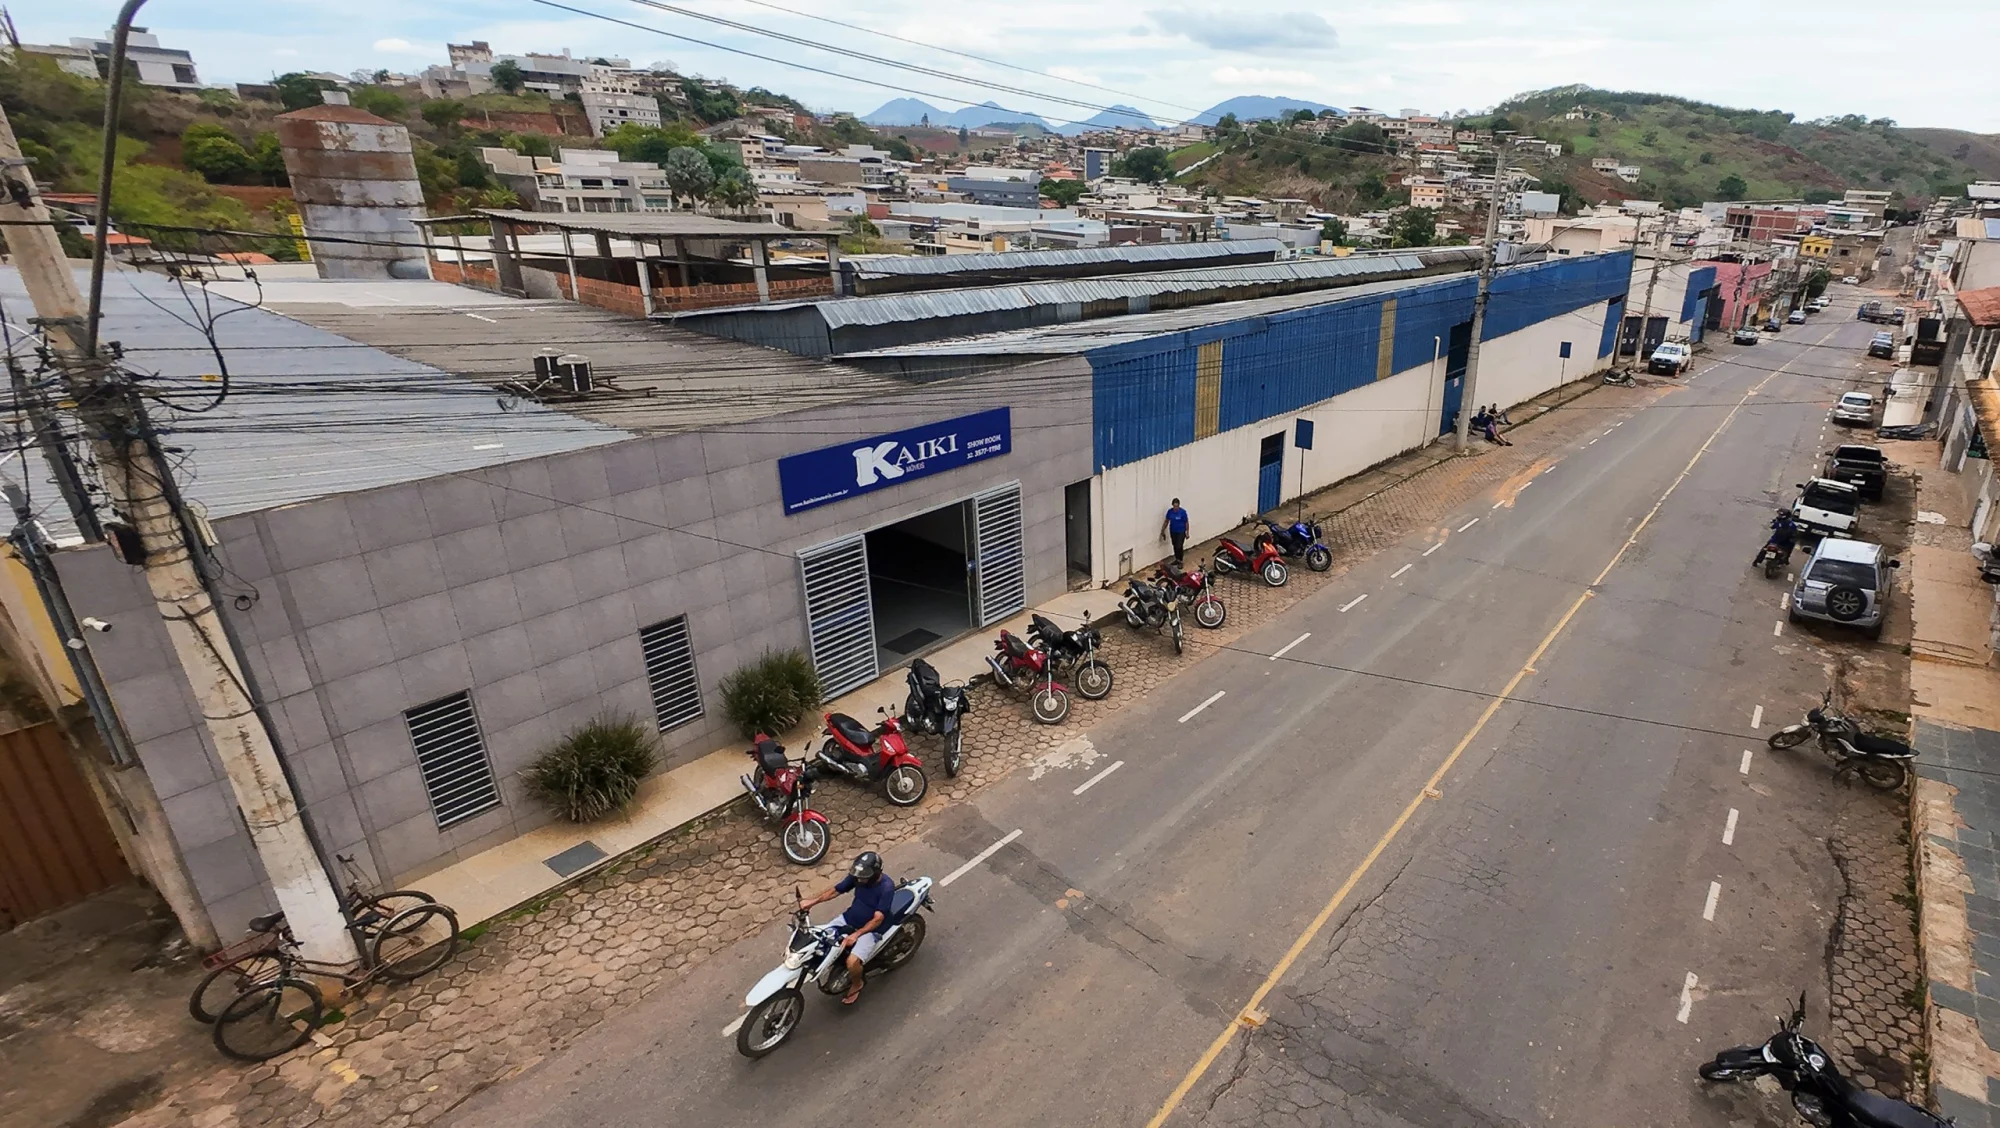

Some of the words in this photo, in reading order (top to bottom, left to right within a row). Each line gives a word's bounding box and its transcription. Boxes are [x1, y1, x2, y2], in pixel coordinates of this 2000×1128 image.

[967, 438, 984, 449] SHOW
[985, 434, 1002, 445] ROOM
[852, 433, 959, 487] KAIKI
